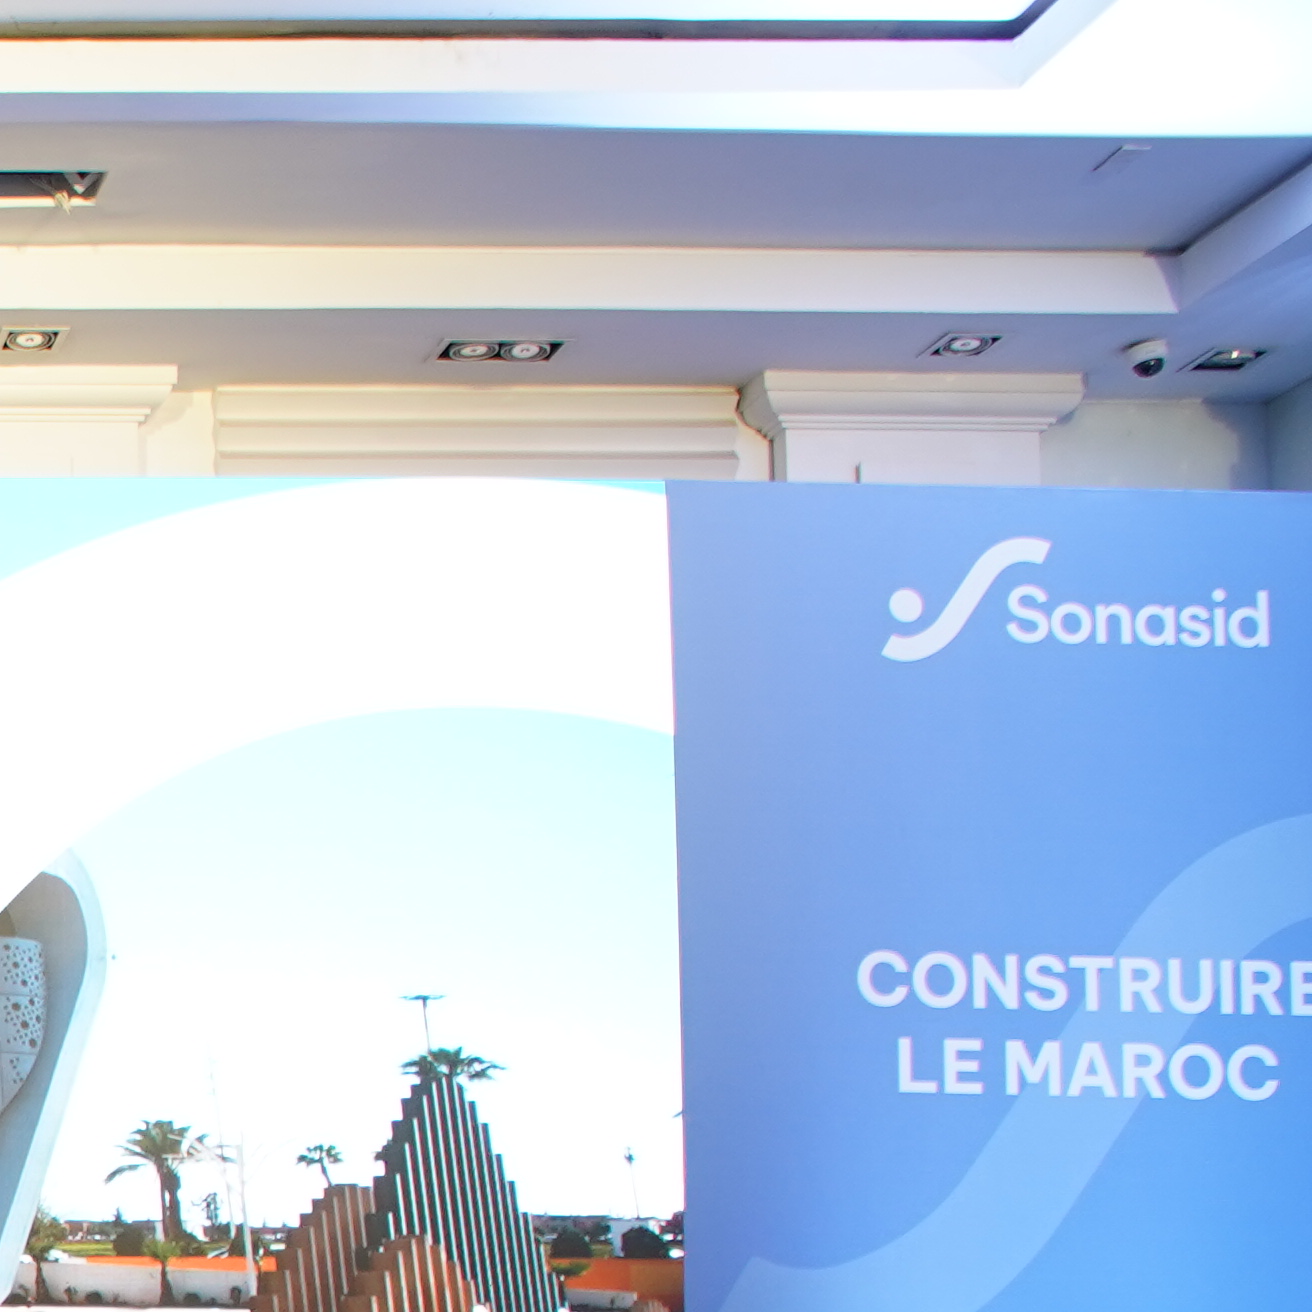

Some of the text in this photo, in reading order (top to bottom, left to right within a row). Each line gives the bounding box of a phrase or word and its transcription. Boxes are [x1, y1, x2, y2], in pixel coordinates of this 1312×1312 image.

[1007, 583, 1270, 648] Sonasid
[857, 949, 1312, 1017] CONSTRUIRE
[897, 1036, 1279, 1101] LE MAROC
